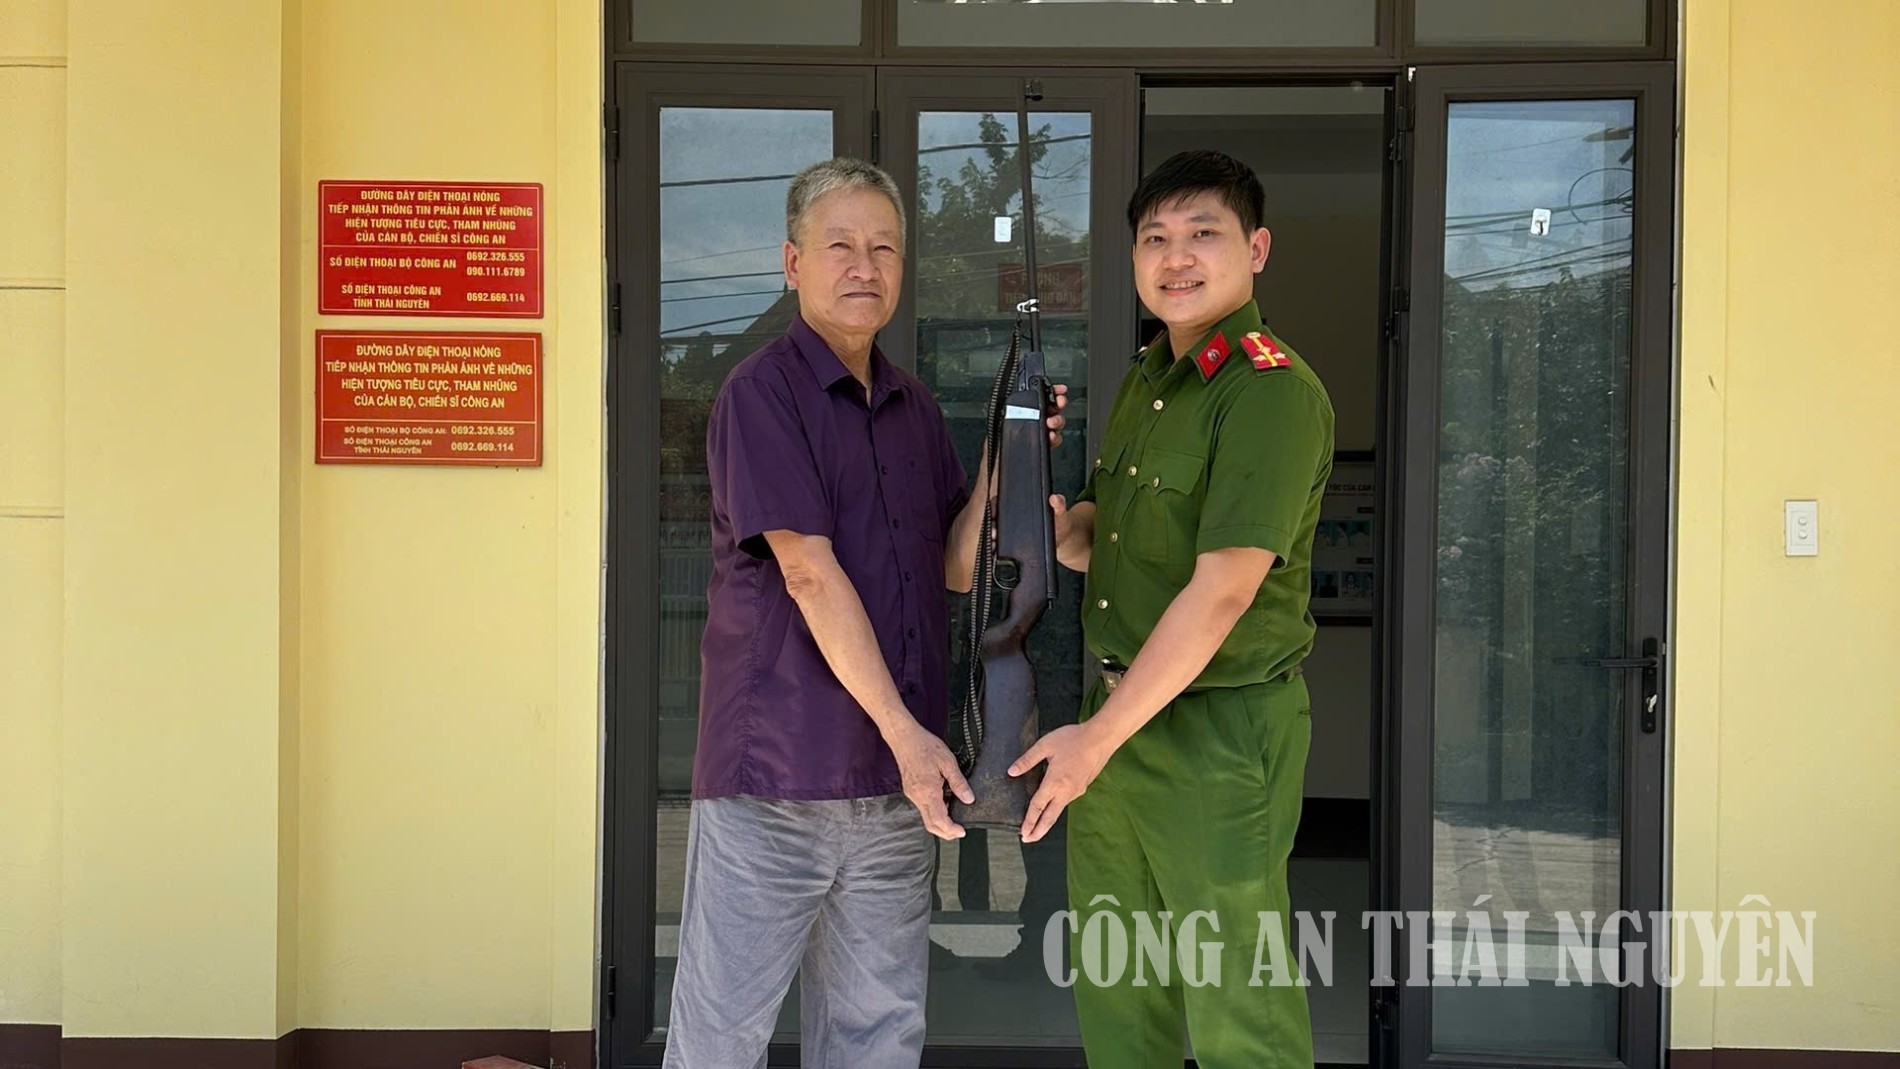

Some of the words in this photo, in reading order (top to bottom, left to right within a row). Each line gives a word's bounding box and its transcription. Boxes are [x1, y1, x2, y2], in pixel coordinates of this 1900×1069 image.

[361, 190, 393, 200] ĐƯỜNG
[396, 191, 415, 201] DÂY
[418, 190, 440, 202] ĐIỆN
[443, 191, 470, 203] THOẠI
[473, 191, 500, 202] NÓNG
[329, 202, 349, 214] TIẾP
[352, 205, 378, 216] NHẬN
[382, 205, 412, 215] THÔNG
[416, 205, 430, 215] TIN
[434, 205, 459, 216] PHẢN
[463, 205, 482, 216] ẢNH
[485, 204, 497, 216] VỀ
[500, 207, 533, 217] NHỮNG
[346, 218, 368, 229] HIỆN
[371, 219, 402, 230] TƯỢNG
[405, 218, 425, 229] TIÊU
[428, 220, 450, 231] CỰC,
[453, 220, 480, 229] THAM
[483, 220, 516, 230] NHŨNG
[356, 231, 375, 242] CỦA
[378, 231, 397, 243] CÁN
[401, 233, 416, 244] BỘ,
[419, 232, 448, 244] CHIẾN
[463, 233, 489, 244] CÔNG
[492, 235, 506, 244] AN
[330, 255, 342, 267] SỐ
[345, 257, 367, 268] ĐIỆN
[370, 258, 396, 269] THOẠI
[399, 257, 412, 269] BỘ
[414, 257, 440, 268] CÔNG
[443, 259, 456, 269] AN
[466, 251, 525, 262] 0692.326.555
[466, 268, 525, 277] 090.111.6789
[1021, 271, 1059, 286] PÒNG
[342, 282, 353, 293] SỐ
[355, 285, 375, 296] ĐIỆN
[377, 285, 402, 296] THOẠI
[404, 284, 427, 295] CÔNG
[429, 286, 441, 295] AN
[375, 298, 394, 309] THÁI
[396, 298, 430, 309] NGUYÊN
[467, 292, 525, 303] 0692.669.114
[356, 343, 393, 356] ĐƯỜNG
[396, 344, 415, 356] DÂY
[417, 345, 439, 358] ĐIỆN
[443, 346, 470, 358] THOẠI
[473, 344, 501, 357] NÓNG
[326, 359, 346, 373] TIẾP
[349, 361, 376, 374] NHẬN
[379, 361, 412, 373] THÔNG
[414, 363, 429, 373] TIN
[432, 362, 458, 374] PHẢN
[460, 362, 481, 375] ẢNH
[483, 362, 496, 374] VỀ
[498, 362, 533, 376] NHỮNG
[342, 378, 364, 391] HIỆN
[367, 379, 402, 391] TƯỢNG
[404, 378, 425, 390] TIÊU
[427, 379, 451, 393] CỰC,
[454, 380, 481, 391] THAM
[483, 379, 517, 392] NHŨNG
[354, 395, 375, 407] CỦA
[377, 394, 397, 407] CÁN
[400, 395, 416, 409] BỘ,
[418, 394, 448, 408] CHIẾN
[461, 395, 489, 408] CÔNG
[491, 398, 505, 408] AN
[345, 426, 354, 434] SỐ
[355, 427, 373, 435] ĐIỆN
[375, 427, 397, 436] THOẠI
[399, 426, 410, 436] BỘ
[412, 426, 432, 435] CÔNG
[451, 425, 514, 436] 0692.326.555
[344, 437, 354, 445] SỐ
[355, 438, 373, 447] ĐIỆN
[375, 439, 397, 447] THOẠI
[399, 437, 420, 446] CÔNG
[451, 442, 514, 452] 0692.669.114
[373, 446, 391, 454] THÁI
[392, 445, 422, 455] NGUYÊN
